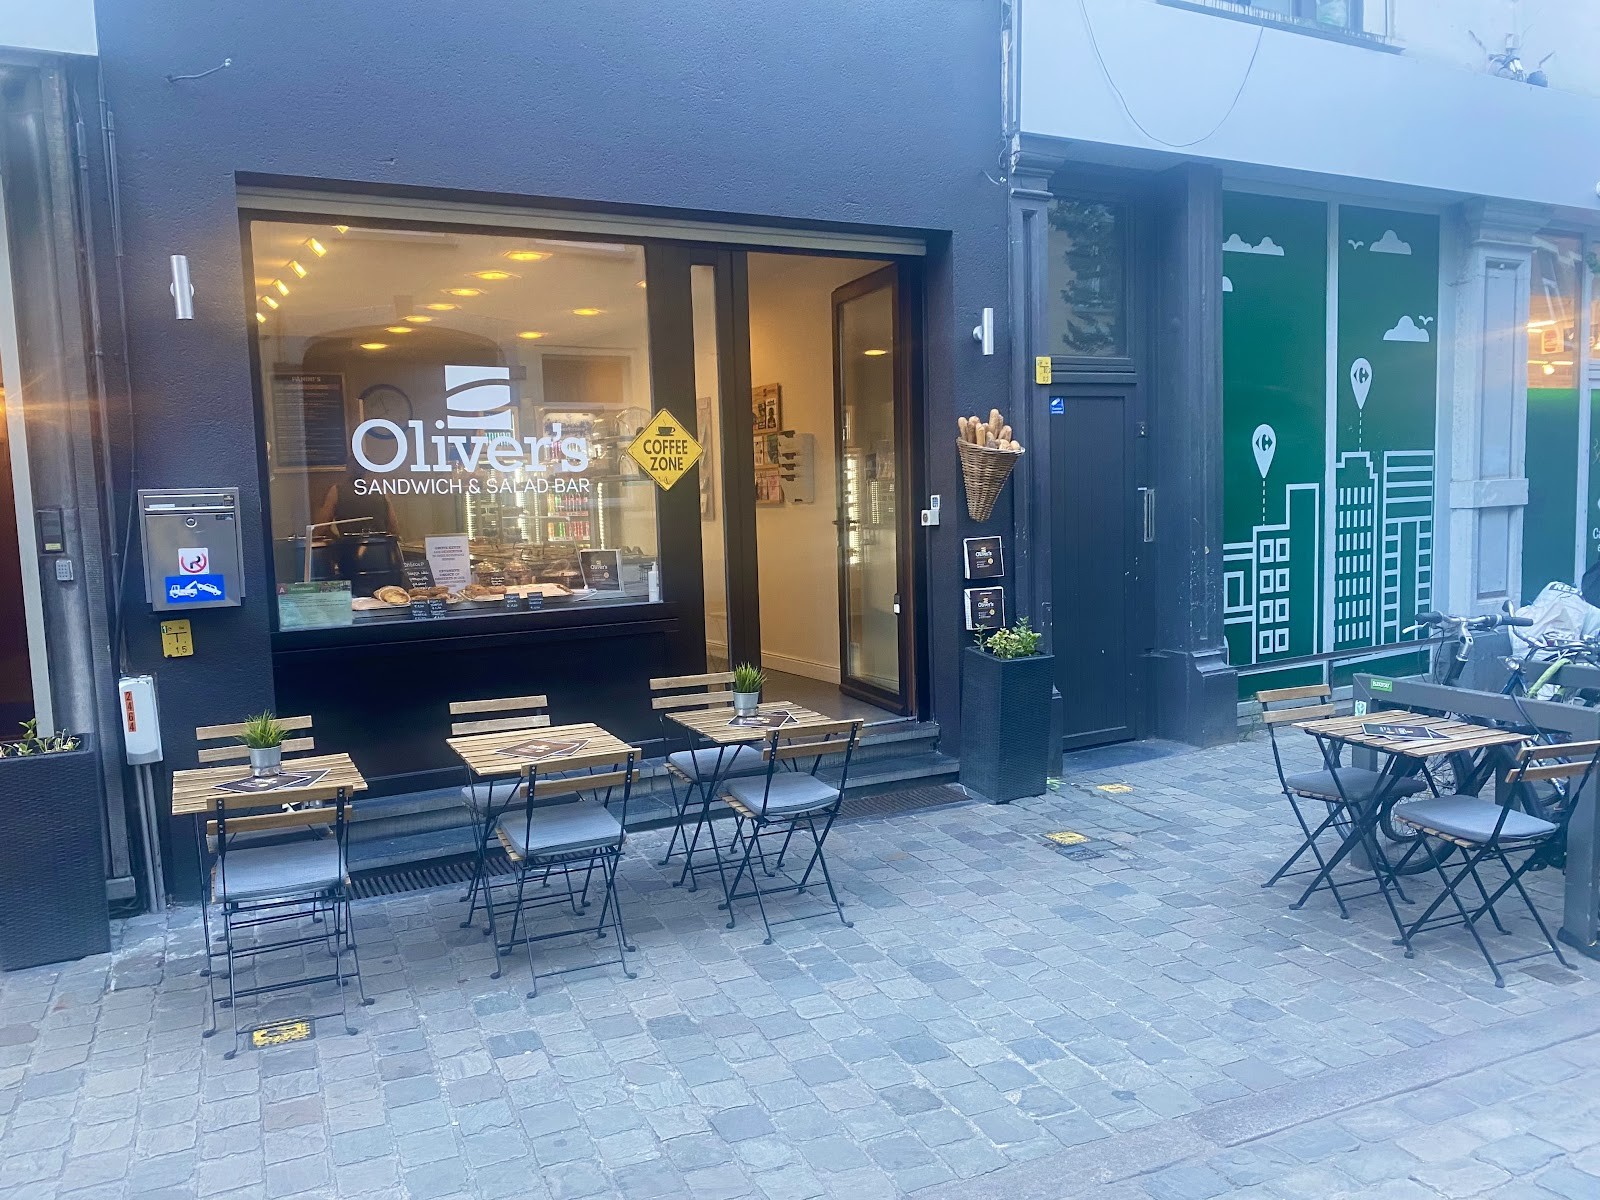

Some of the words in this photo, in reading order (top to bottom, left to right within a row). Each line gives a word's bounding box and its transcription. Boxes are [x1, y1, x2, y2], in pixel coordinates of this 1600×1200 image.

[352, 419, 590, 472] Oliver's
[643, 439, 688, 455] COFFEE
[650, 456, 684, 471] ZONE
[353, 478, 462, 496] SANDWICH
[468, 478, 481, 494] &
[486, 478, 549, 494] SALAD
[554, 478, 591, 493] BAR
